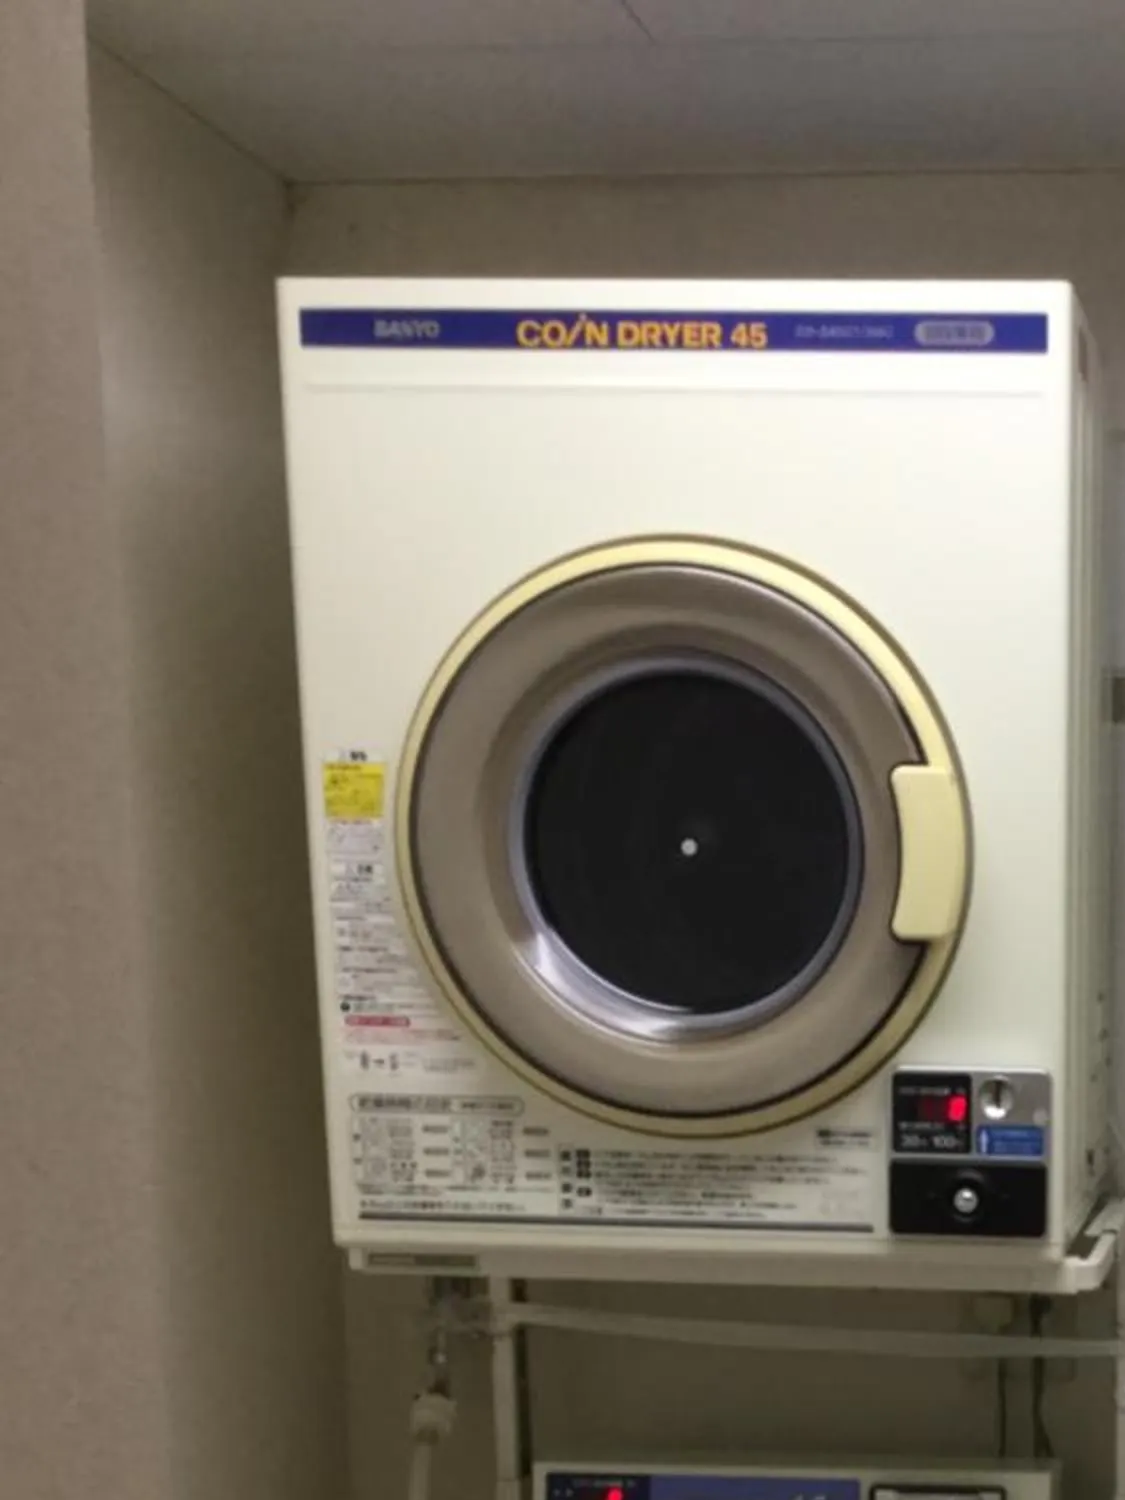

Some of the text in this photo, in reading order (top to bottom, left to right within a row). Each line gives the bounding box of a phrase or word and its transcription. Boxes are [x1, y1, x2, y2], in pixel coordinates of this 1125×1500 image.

[373, 319, 441, 338] SANYO
[617, 320, 723, 348] DRYER
[730, 321, 768, 348] 45
